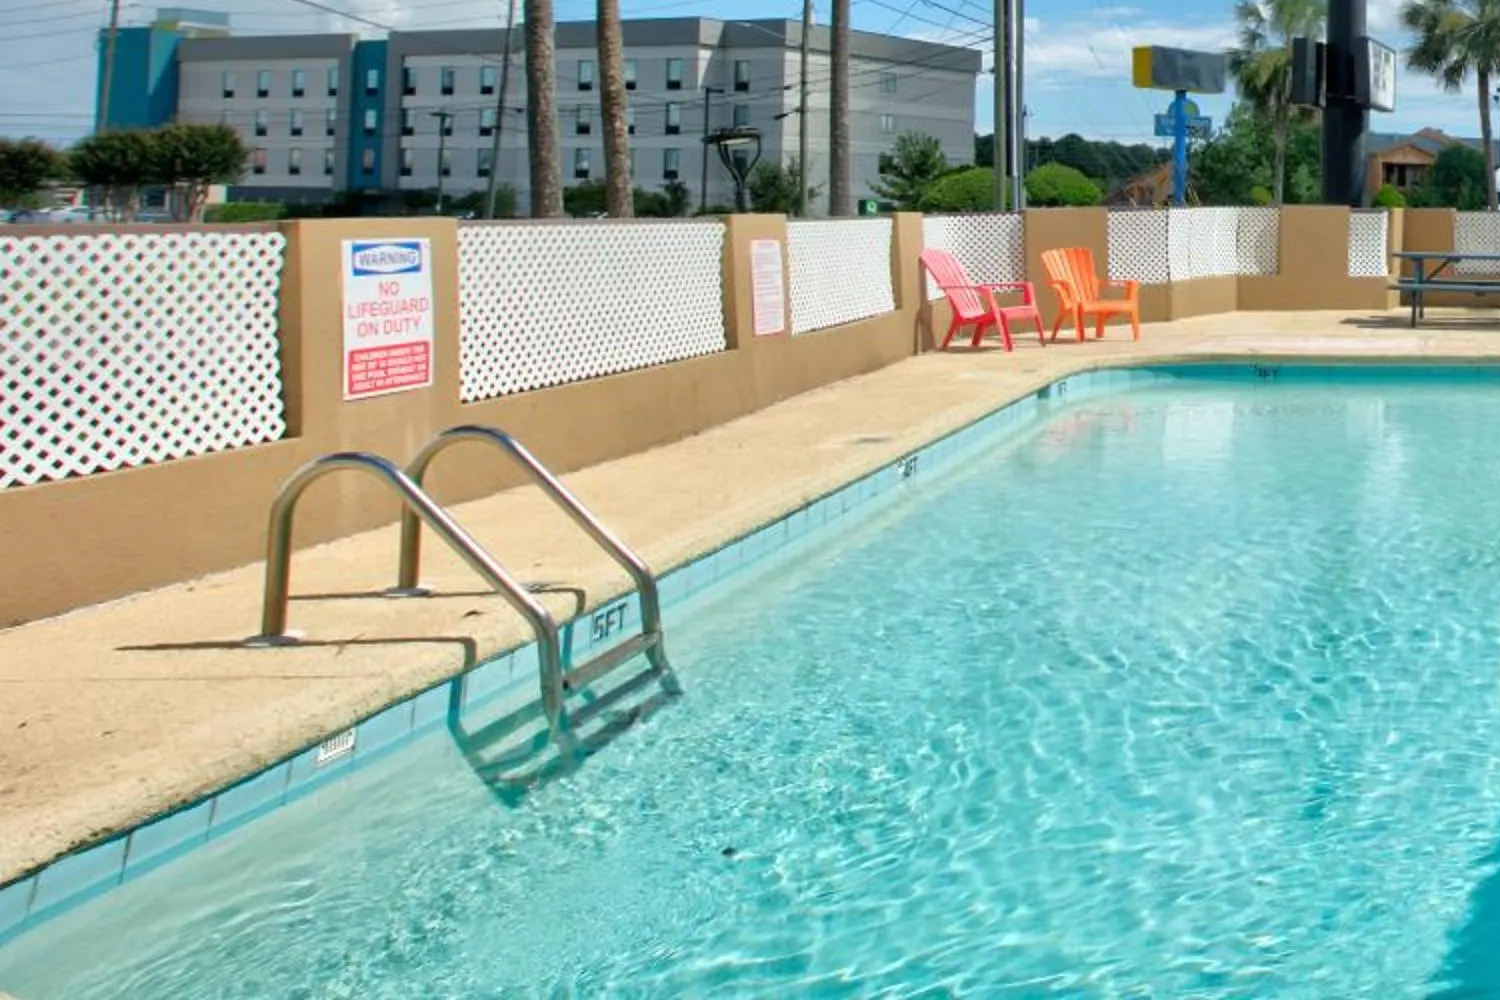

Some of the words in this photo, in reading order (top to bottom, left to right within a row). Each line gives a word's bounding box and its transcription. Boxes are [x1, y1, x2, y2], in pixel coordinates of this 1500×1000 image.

[359, 251, 418, 266] WARNING
[378, 281, 400, 297] NO
[348, 297, 429, 320] LIFEGUARD
[357, 321, 379, 338] ON
[383, 317, 421, 335] DUTY
